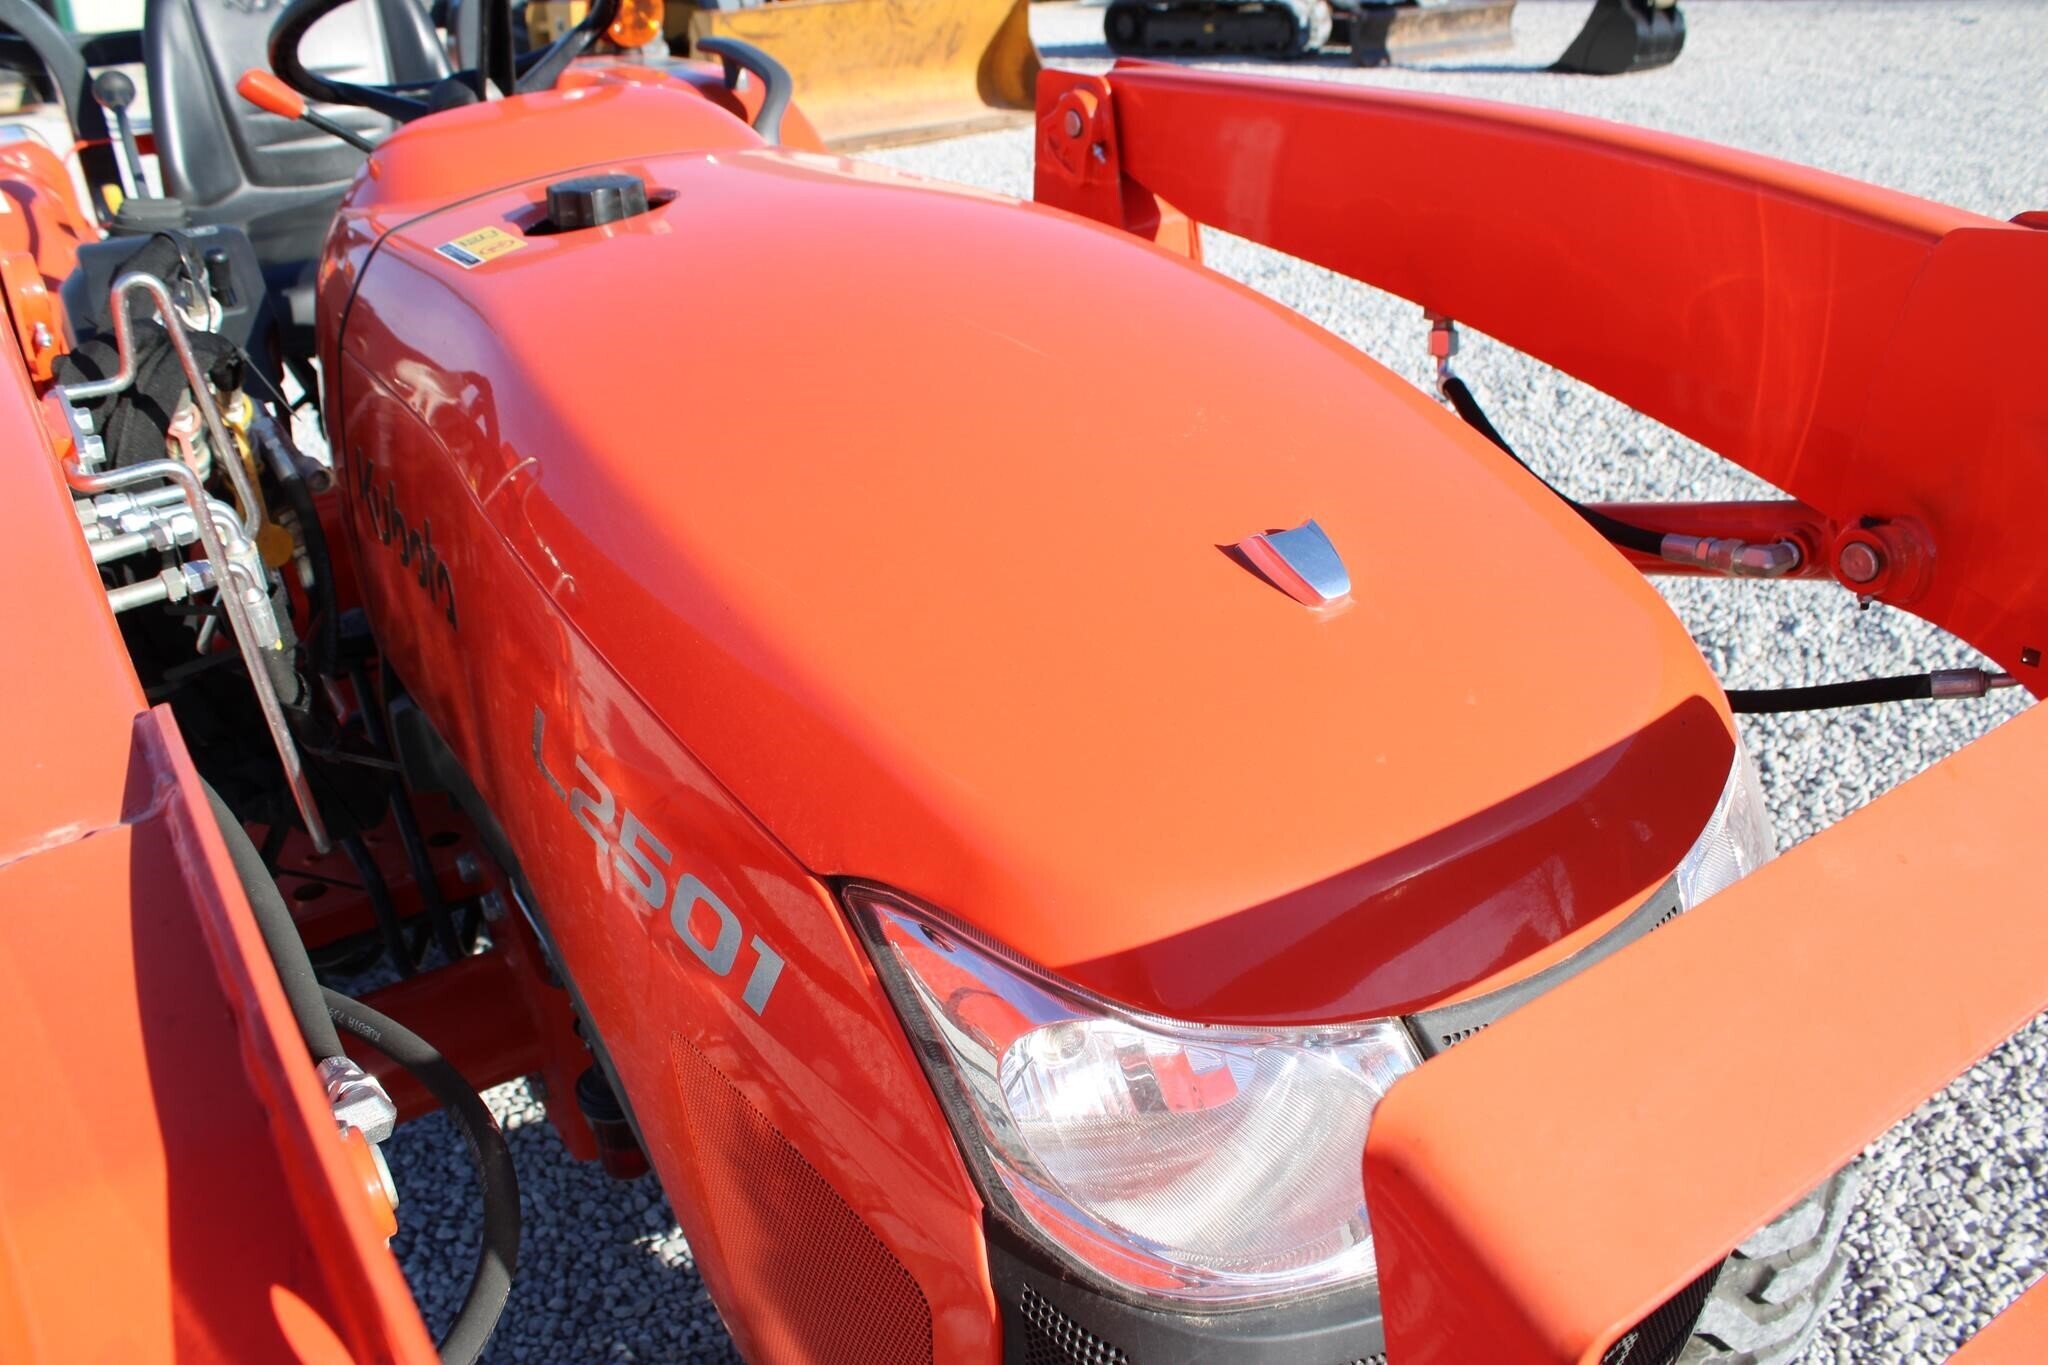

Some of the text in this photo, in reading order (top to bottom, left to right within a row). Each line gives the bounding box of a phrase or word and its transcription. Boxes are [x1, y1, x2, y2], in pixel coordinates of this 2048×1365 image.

[356, 445, 459, 632] Kubota
[533, 704, 785, 1016] L2501
[348, 1016, 382, 1041] KUBOTA
